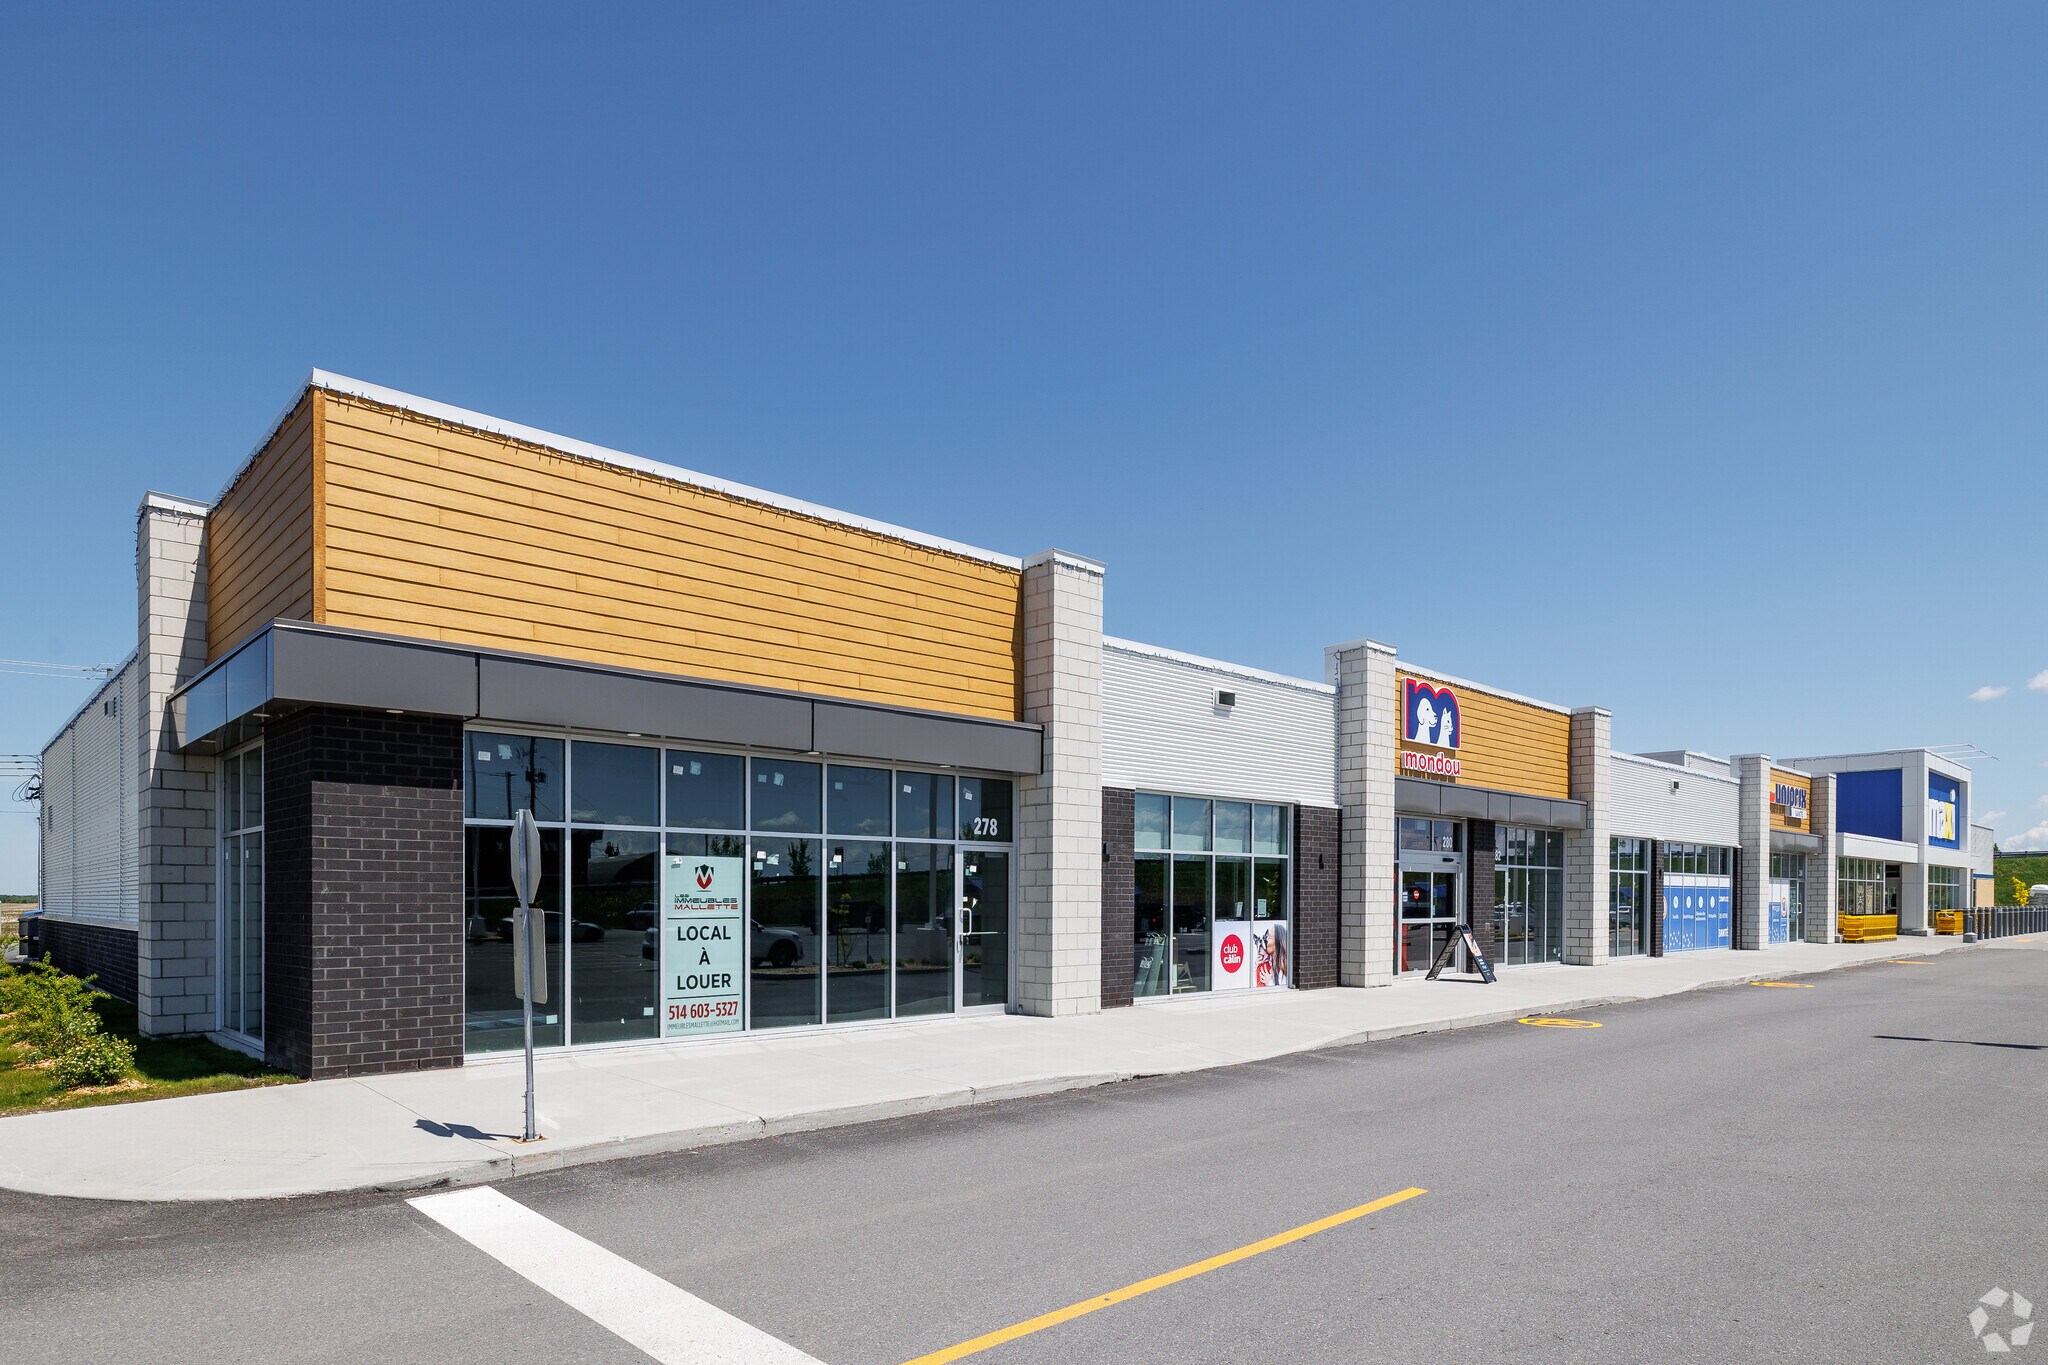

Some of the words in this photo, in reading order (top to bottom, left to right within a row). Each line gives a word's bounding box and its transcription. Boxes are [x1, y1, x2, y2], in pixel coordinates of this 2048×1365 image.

[1404, 751, 1461, 776] mondou
[1928, 788, 1956, 841] maxi
[973, 816, 998, 836] 278
[1442, 836, 1453, 848] 280
[677, 925, 731, 941] LOCAL
[698, 947, 711, 965] À
[1223, 943, 1238, 954] club
[677, 973, 731, 990] LOUER
[668, 1004, 687, 1020] 514
[690, 1001, 739, 1018] 603-5327
[667, 1018, 740, 1030] IMMEUBLESMALLETTE@HOTMAIL.COM
